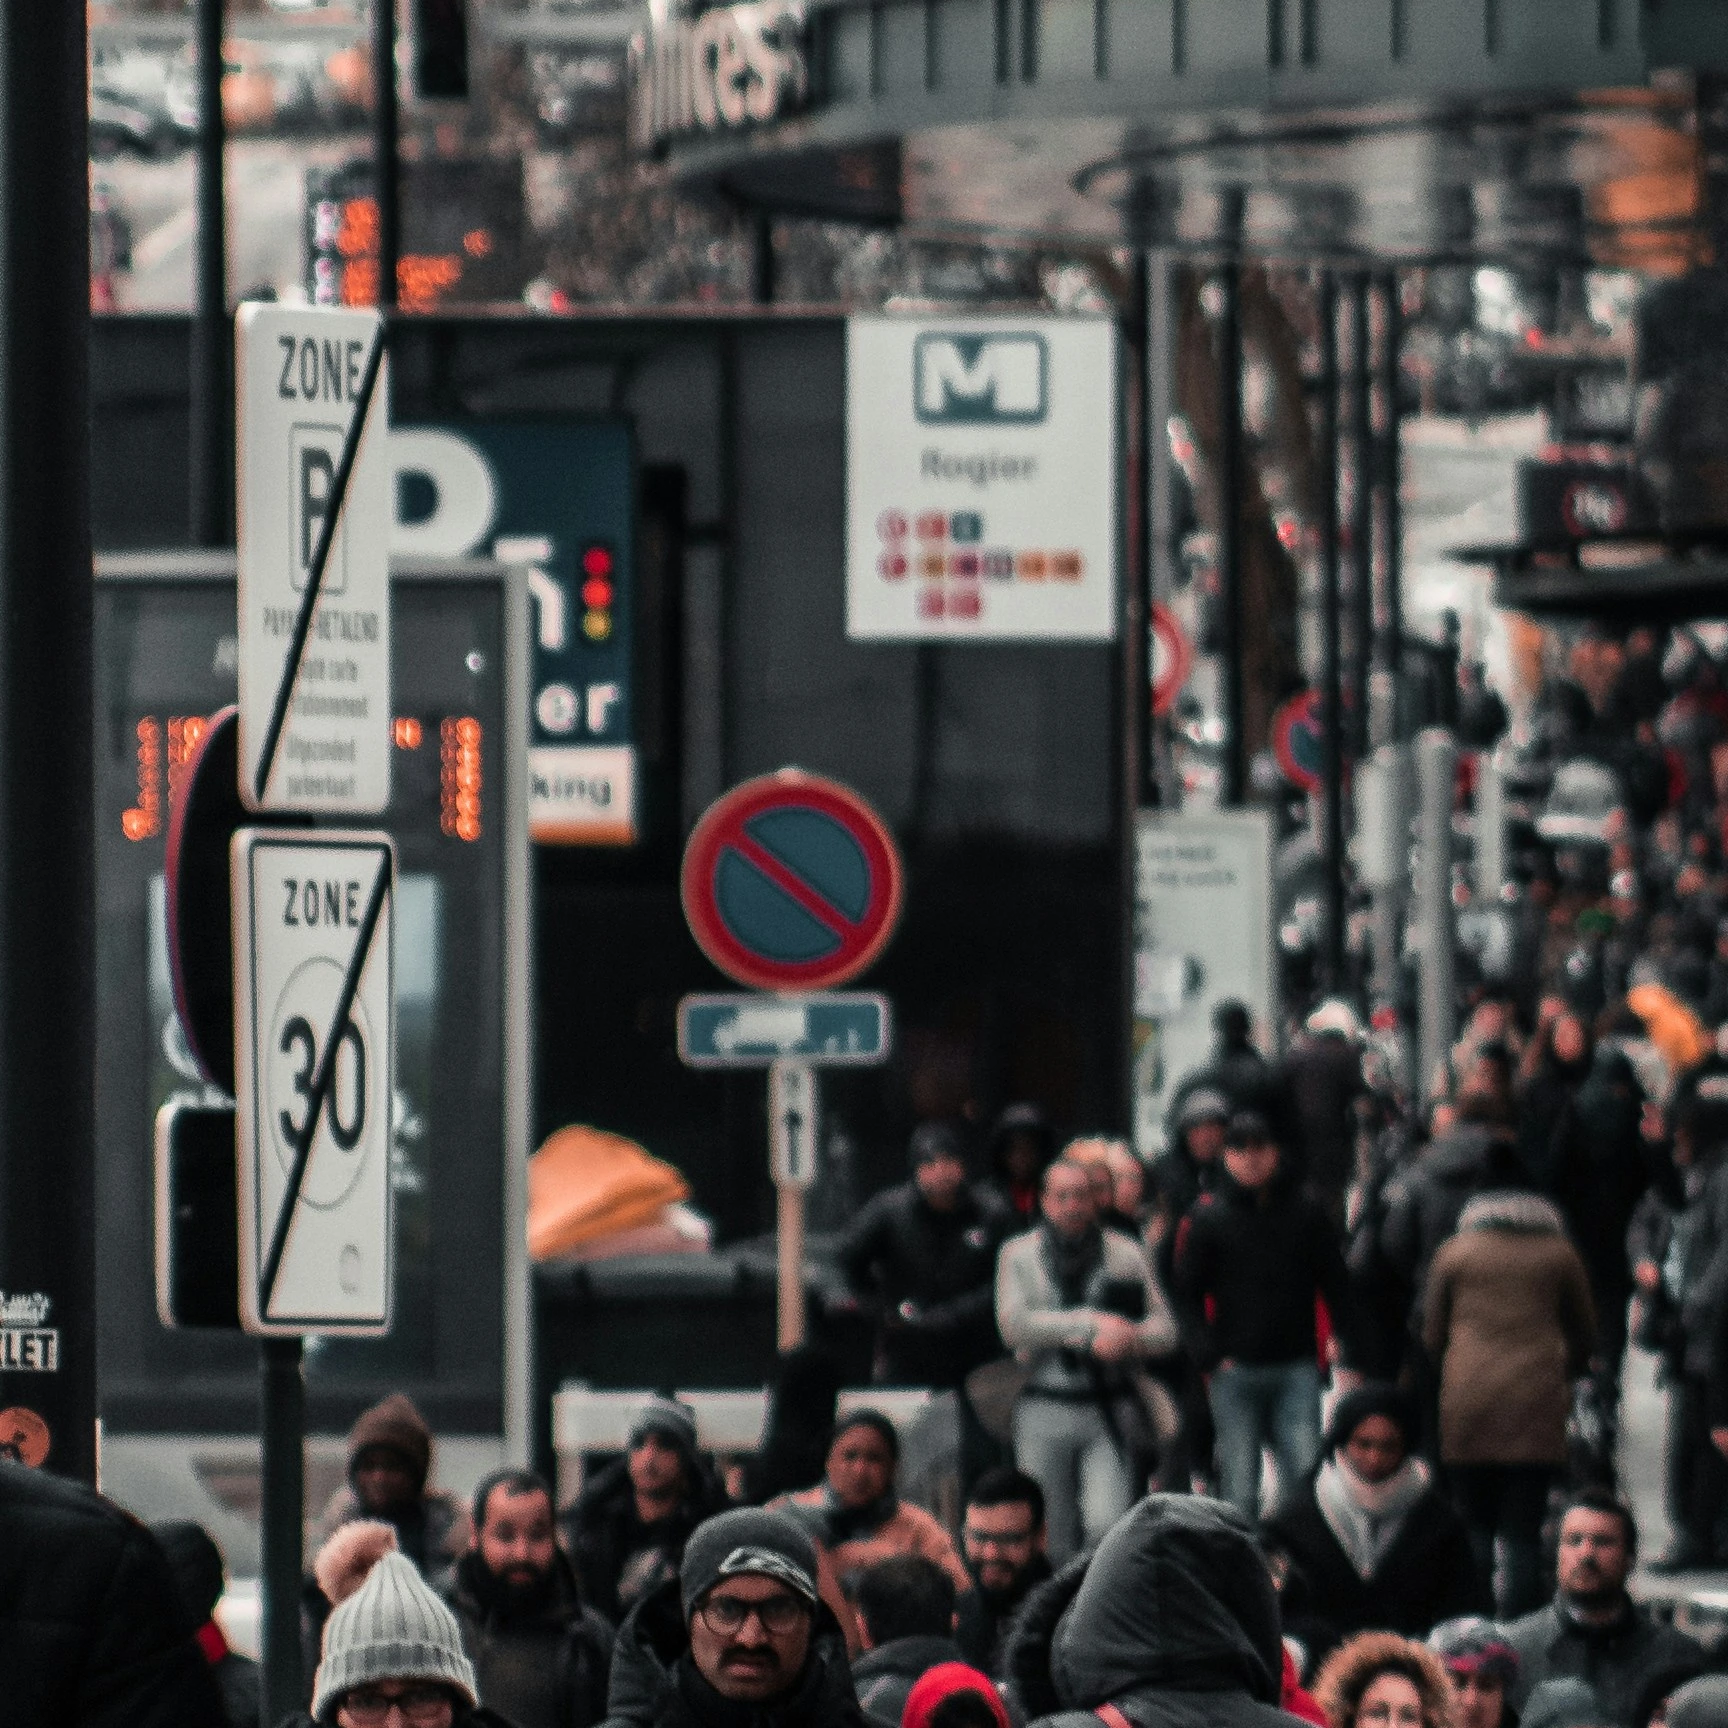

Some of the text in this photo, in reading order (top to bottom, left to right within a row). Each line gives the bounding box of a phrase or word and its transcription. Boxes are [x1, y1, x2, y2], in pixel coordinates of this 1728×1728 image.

[278, 334, 363, 404] ZONE
[922, 338, 1038, 415] M
[920, 448, 1037, 489] Rogier
[282, 877, 361, 928] ZONE
[279, 1014, 366, 1149] 30
